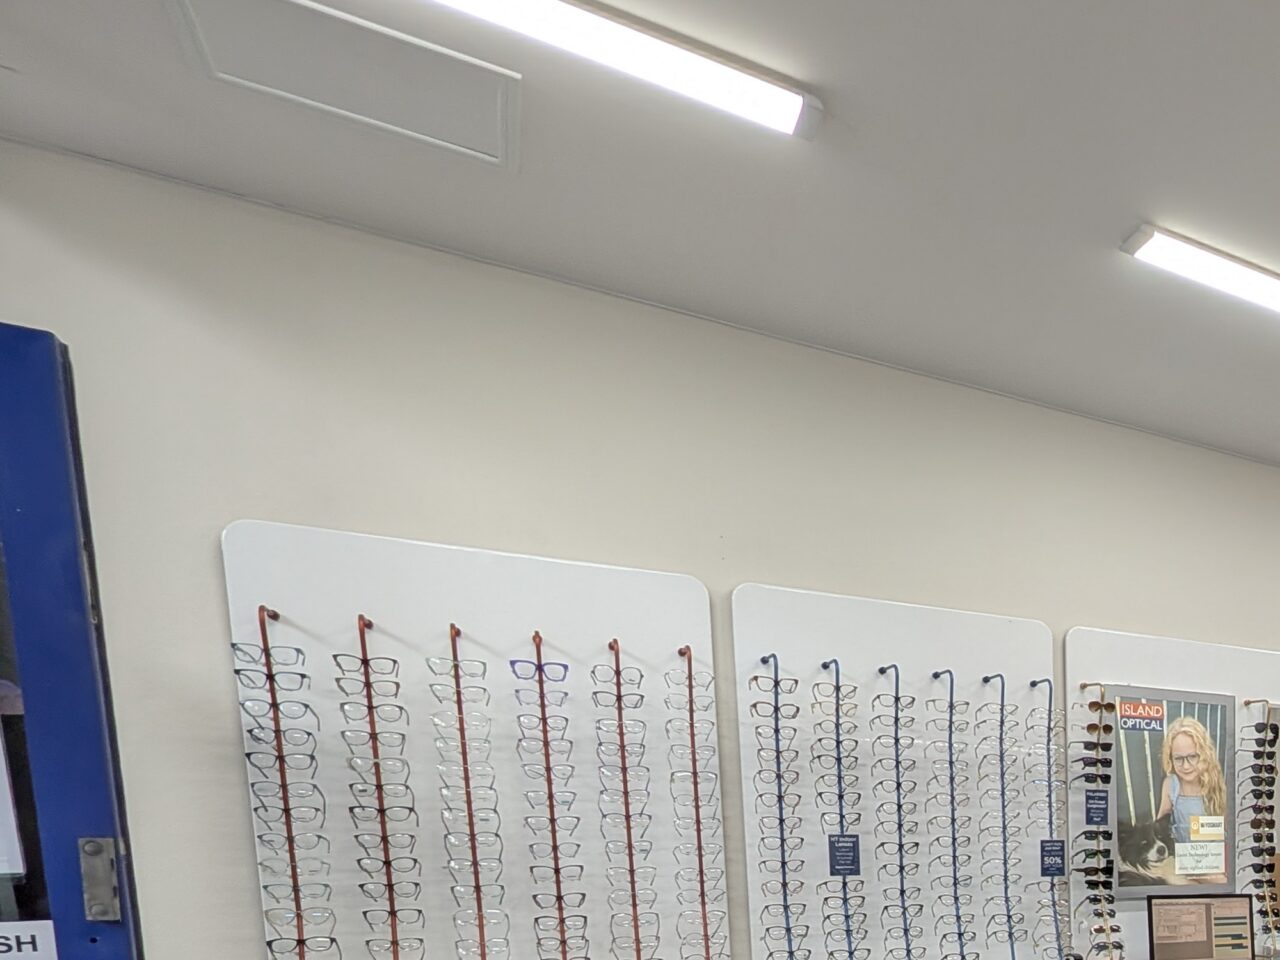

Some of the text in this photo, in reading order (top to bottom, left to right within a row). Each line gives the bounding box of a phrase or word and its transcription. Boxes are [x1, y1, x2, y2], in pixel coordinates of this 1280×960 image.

[1121, 703, 1163, 717] ISLAND
[1121, 718, 1163, 730] OPTICAL
[1043, 856, 1062, 864] 50%
